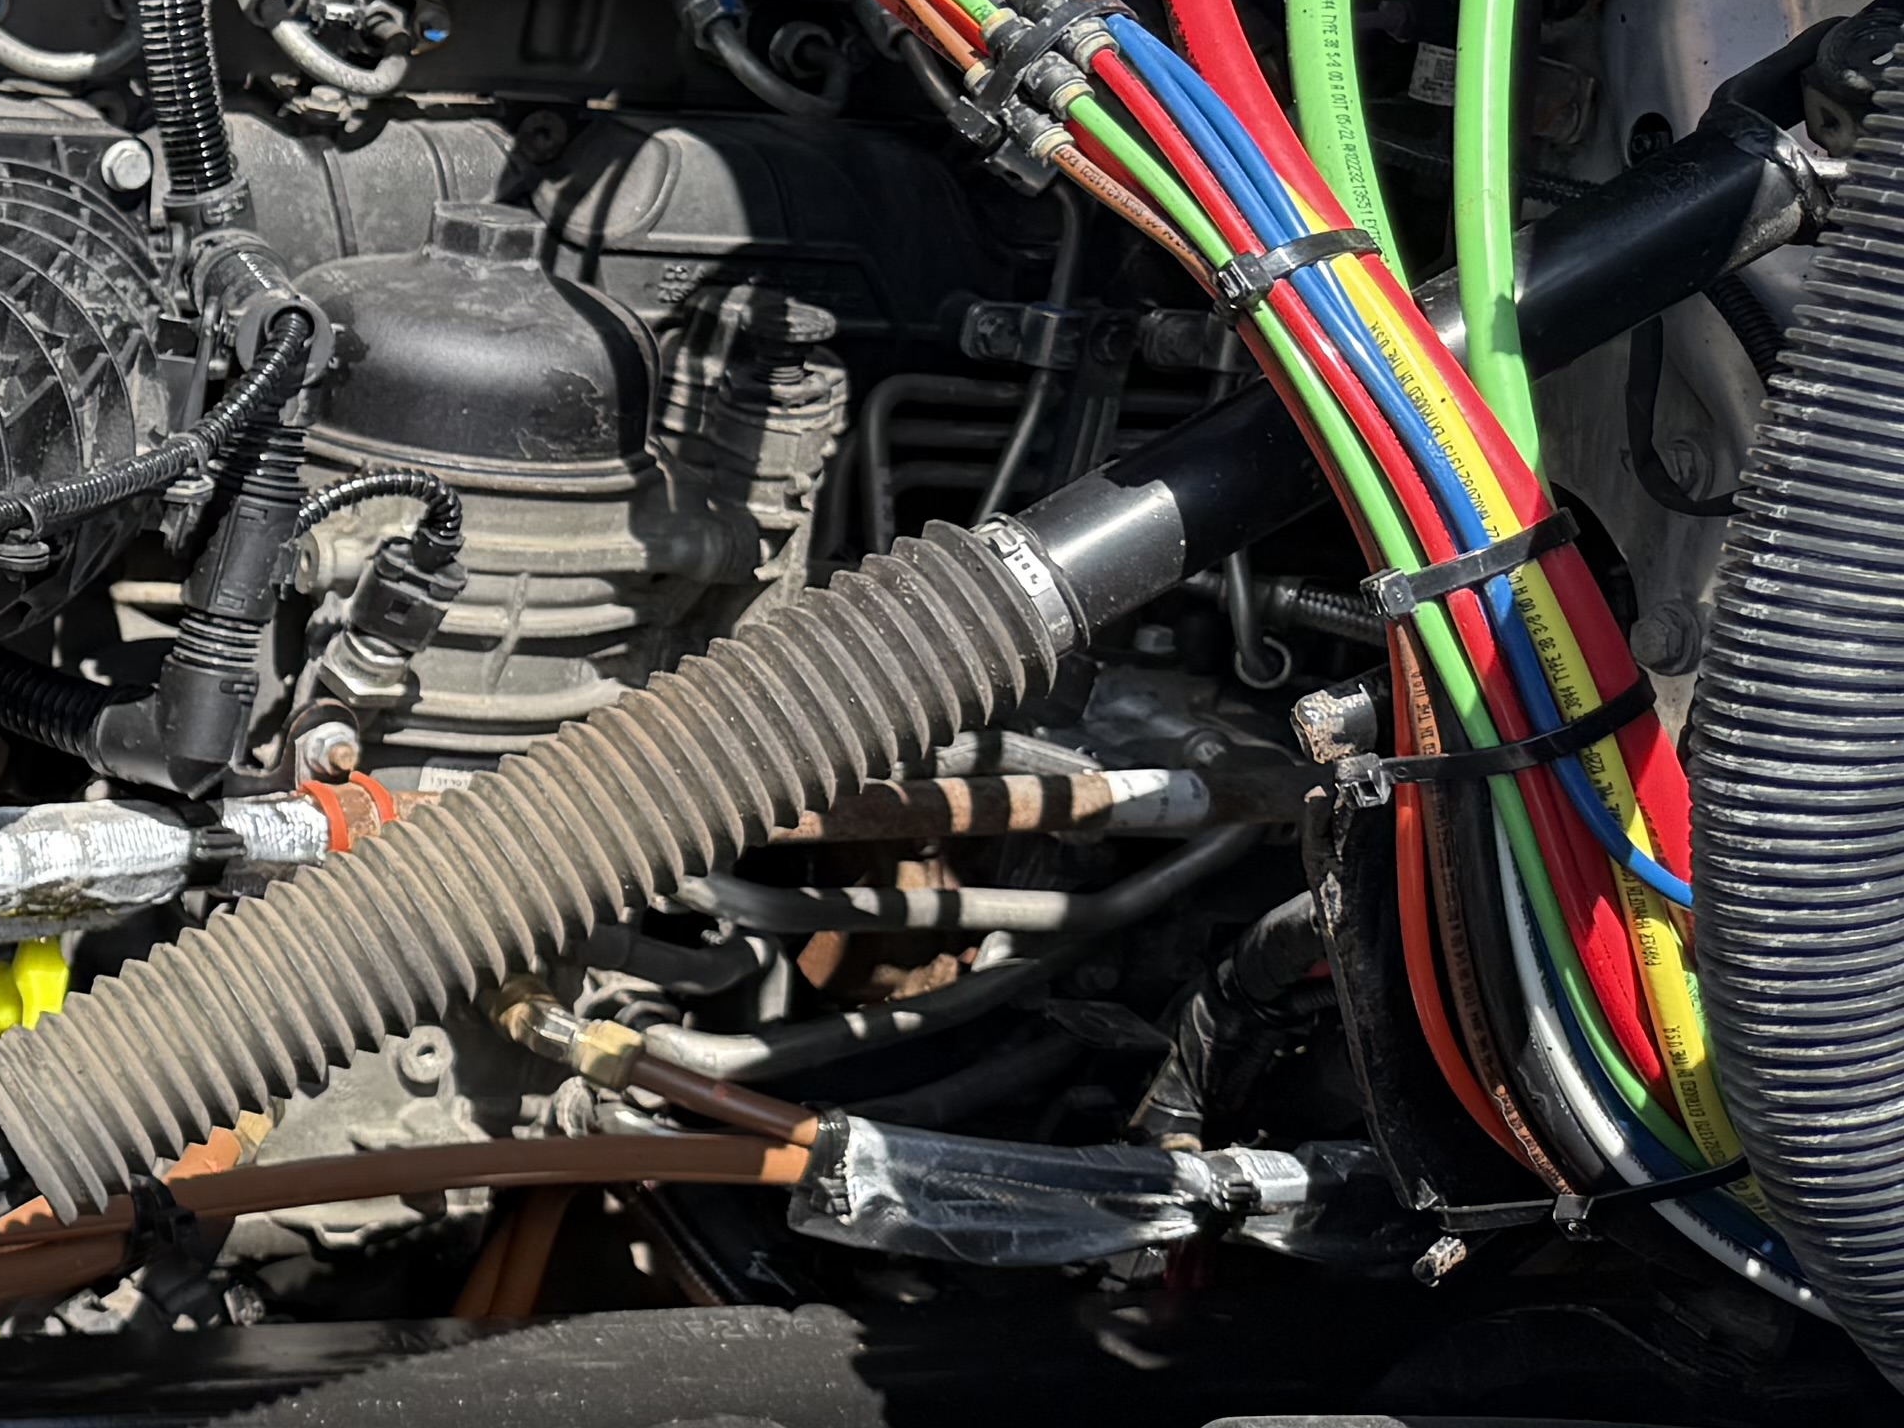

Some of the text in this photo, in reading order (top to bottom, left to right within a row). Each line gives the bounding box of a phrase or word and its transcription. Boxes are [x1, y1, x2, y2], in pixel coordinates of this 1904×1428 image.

[1320, 14, 1339, 36] TYPE
[1387, 348, 1404, 368] THE
[1544, 652, 1571, 684] TYPE
[1668, 1049, 1687, 1067] THE
